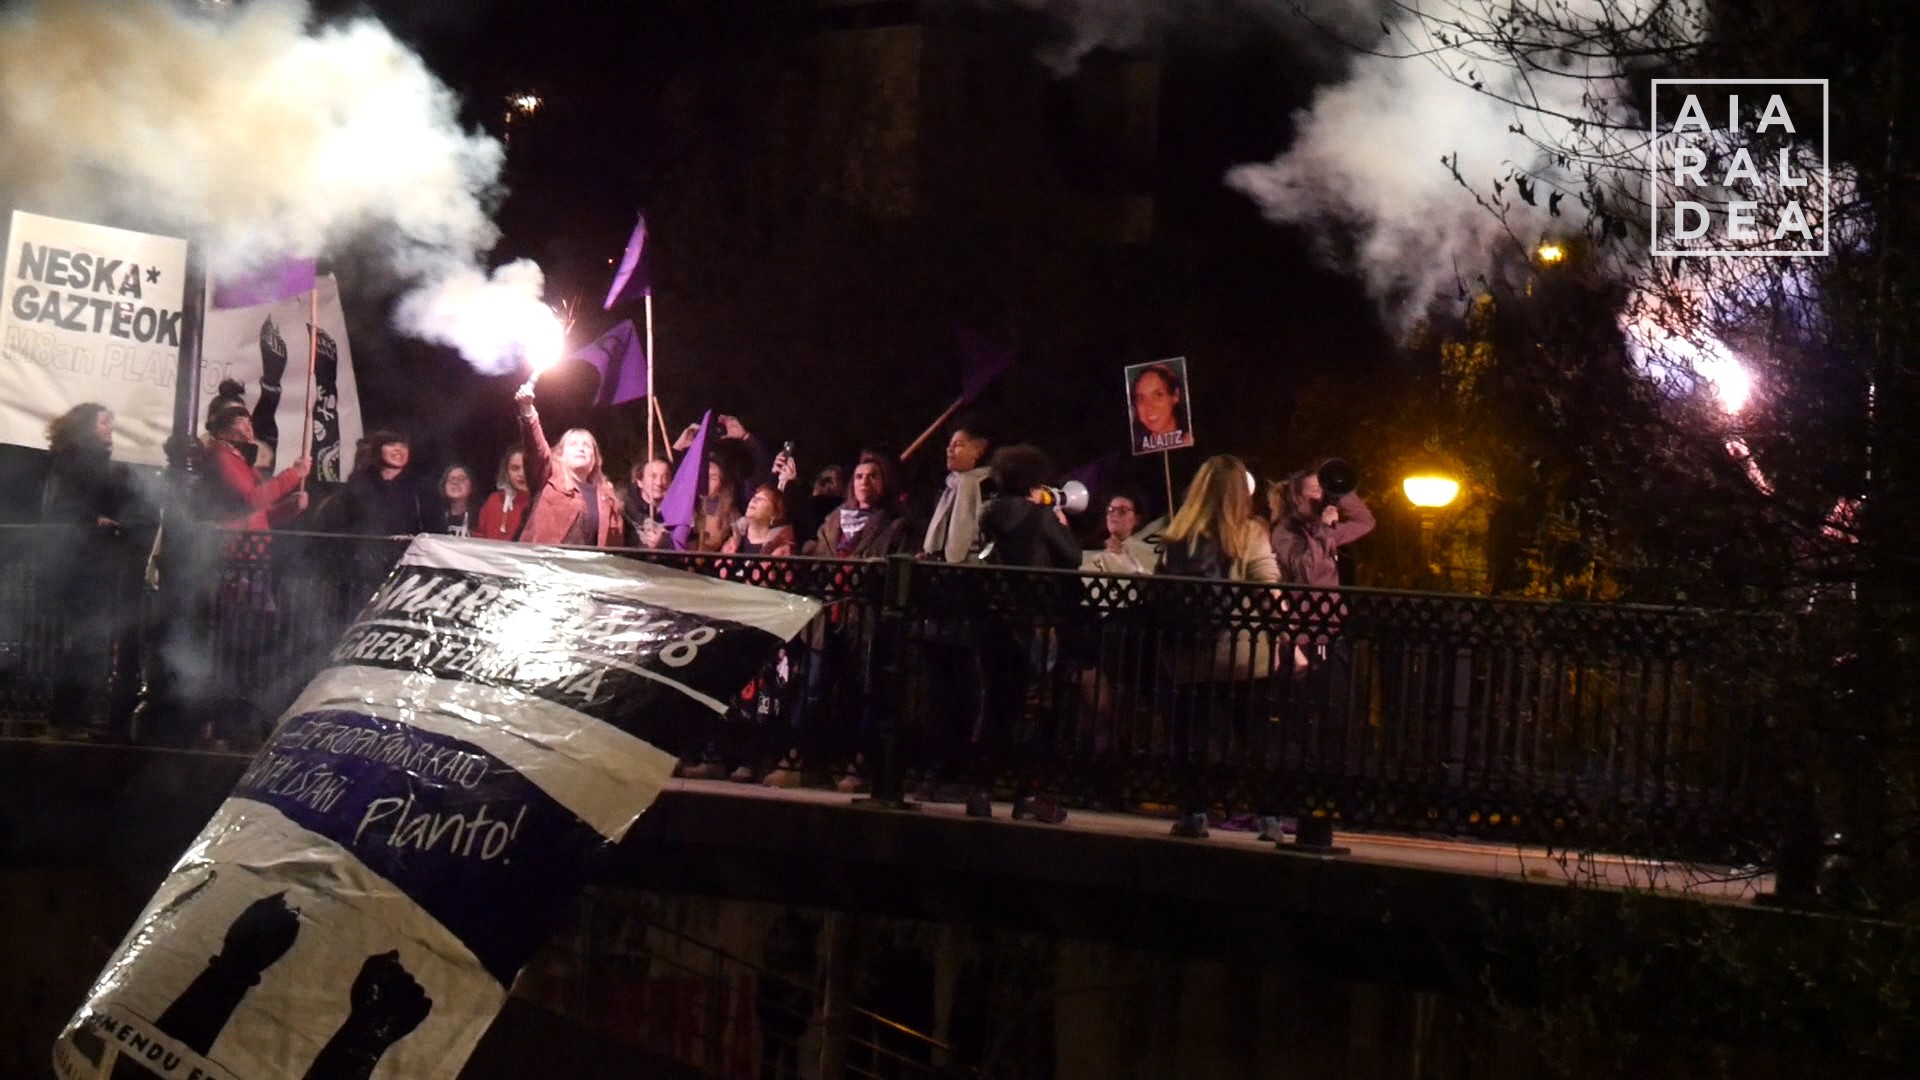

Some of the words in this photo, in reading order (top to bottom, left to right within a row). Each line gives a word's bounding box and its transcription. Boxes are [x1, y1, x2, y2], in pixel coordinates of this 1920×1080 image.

[12, 285, 183, 347] GAZTEOK
[1142, 430, 1183, 449] ALAITZ
[659, 626, 716, 667] 8
[352, 784, 527, 865] Planto!
